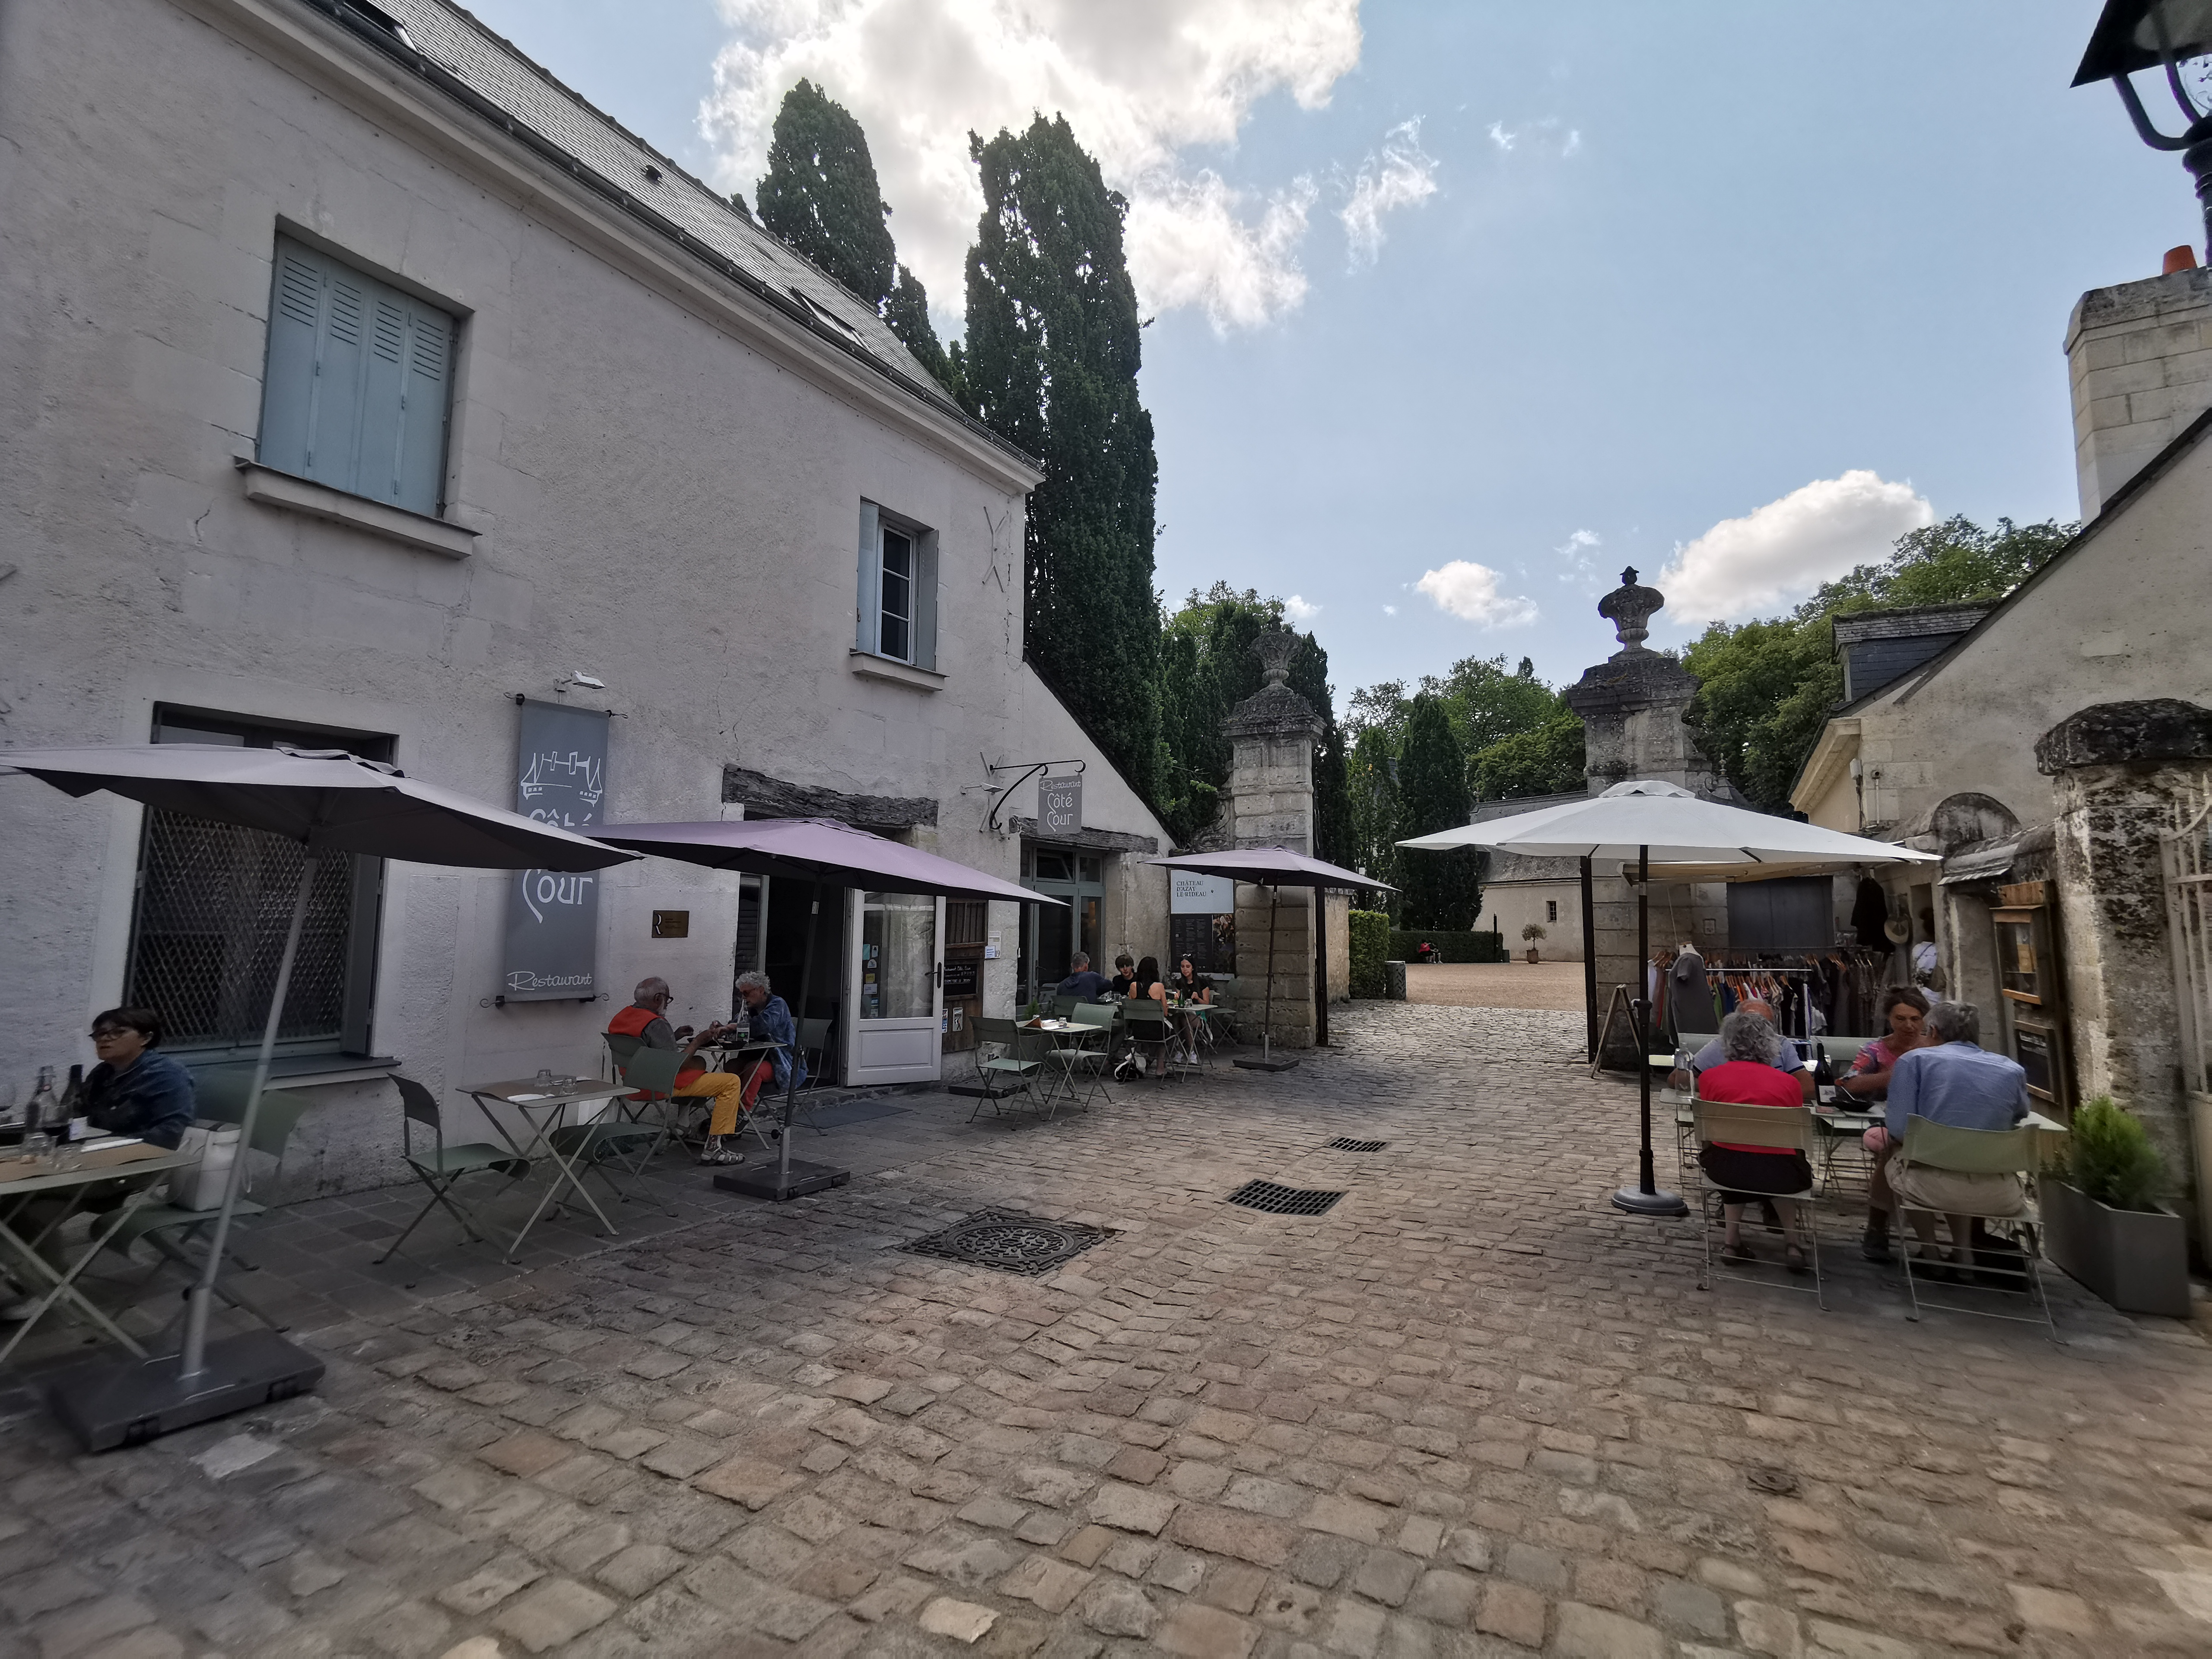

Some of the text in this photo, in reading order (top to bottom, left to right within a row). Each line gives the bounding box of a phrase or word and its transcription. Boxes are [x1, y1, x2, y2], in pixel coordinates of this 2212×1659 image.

[1039, 780, 1081, 791] Restaurant
[1047, 792, 1073, 814] Côté
[1047, 811, 1073, 832] Cour
[522, 869, 593, 923] Cour
[507, 971, 592, 991] Restaurant
